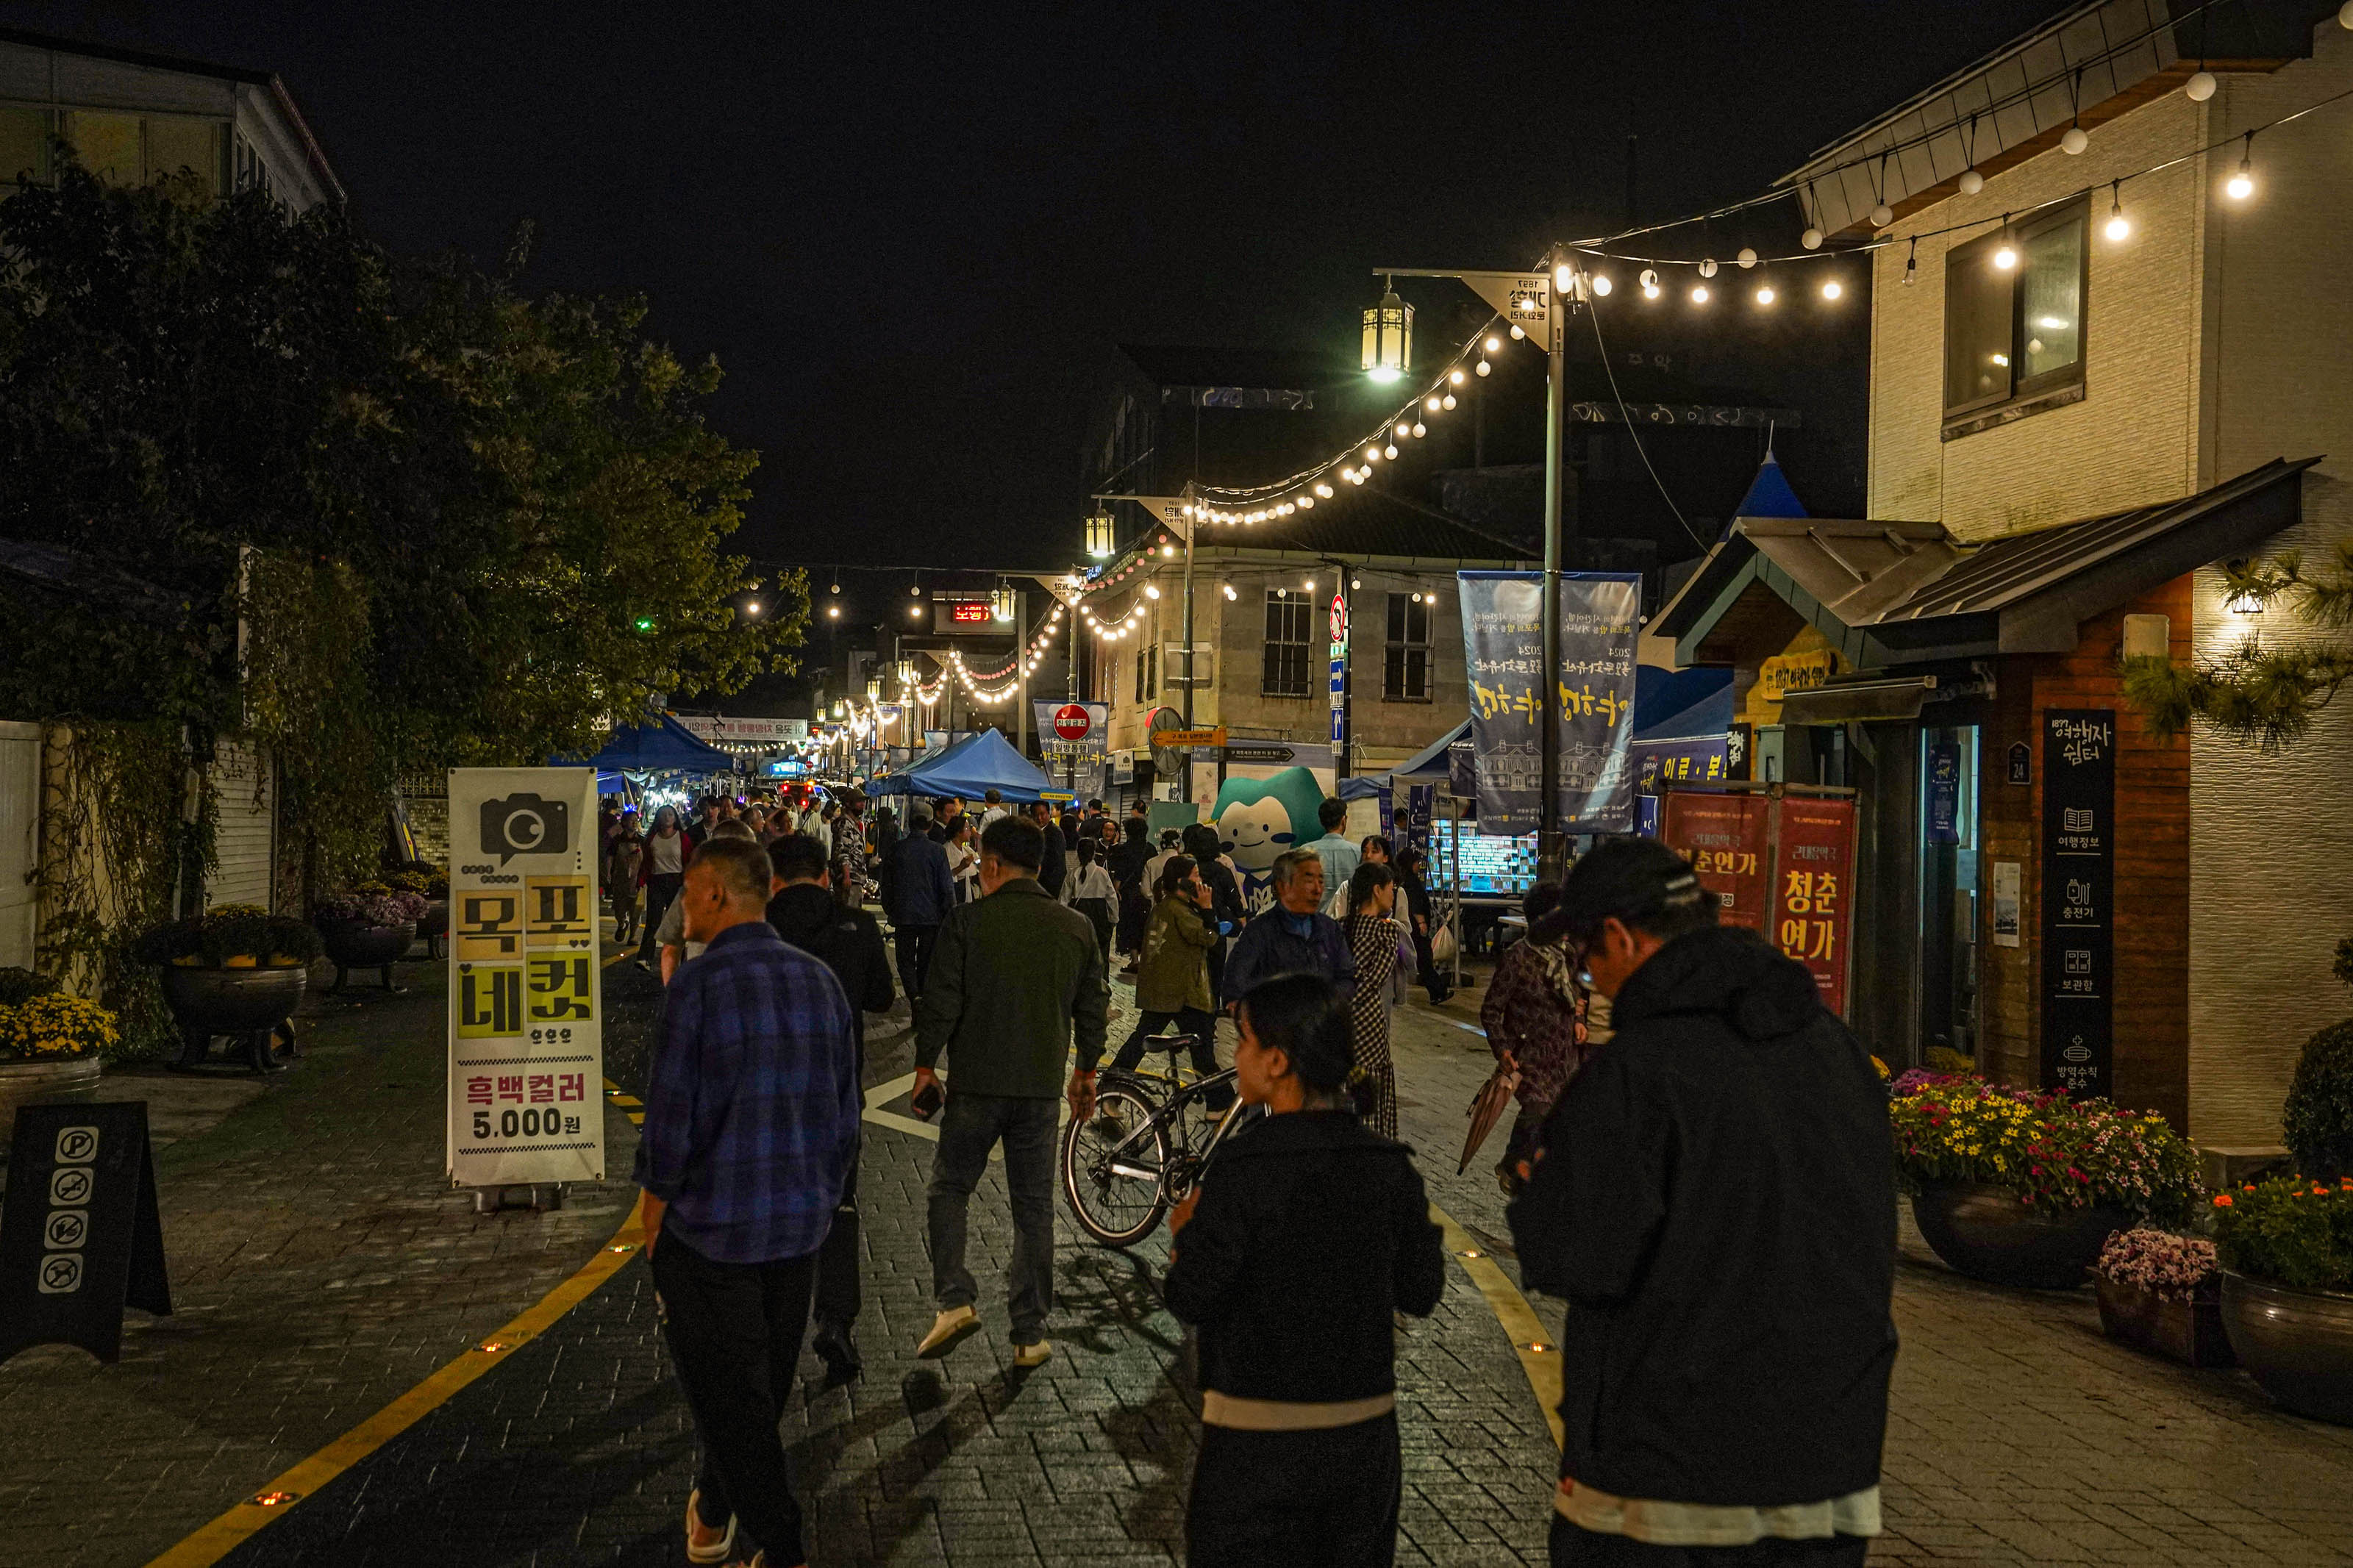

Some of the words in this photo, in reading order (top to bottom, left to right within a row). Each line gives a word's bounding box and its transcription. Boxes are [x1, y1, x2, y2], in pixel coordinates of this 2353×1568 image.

[2052, 719, 2068, 728] 1897
[2056, 720, 2112, 747] 여행자
[1054, 744, 1087, 753] 일방통행
[2063, 740, 2100, 766] 쉼터
[2013, 763, 2024, 778] 24
[2058, 836, 2100, 848] 여행정보
[1785, 870, 1838, 914] 청춘
[457, 885, 590, 953] 목포
[2063, 906, 2093, 919] 충전기
[1782, 920, 1836, 961] 연가
[2062, 979, 2093, 992] 보관함
[461, 960, 591, 1033] 네컷
[2057, 1066, 2098, 1078] 방역수칙
[467, 1073, 585, 1106] 흑백컬러
[2067, 1078, 2088, 1089] 준수
